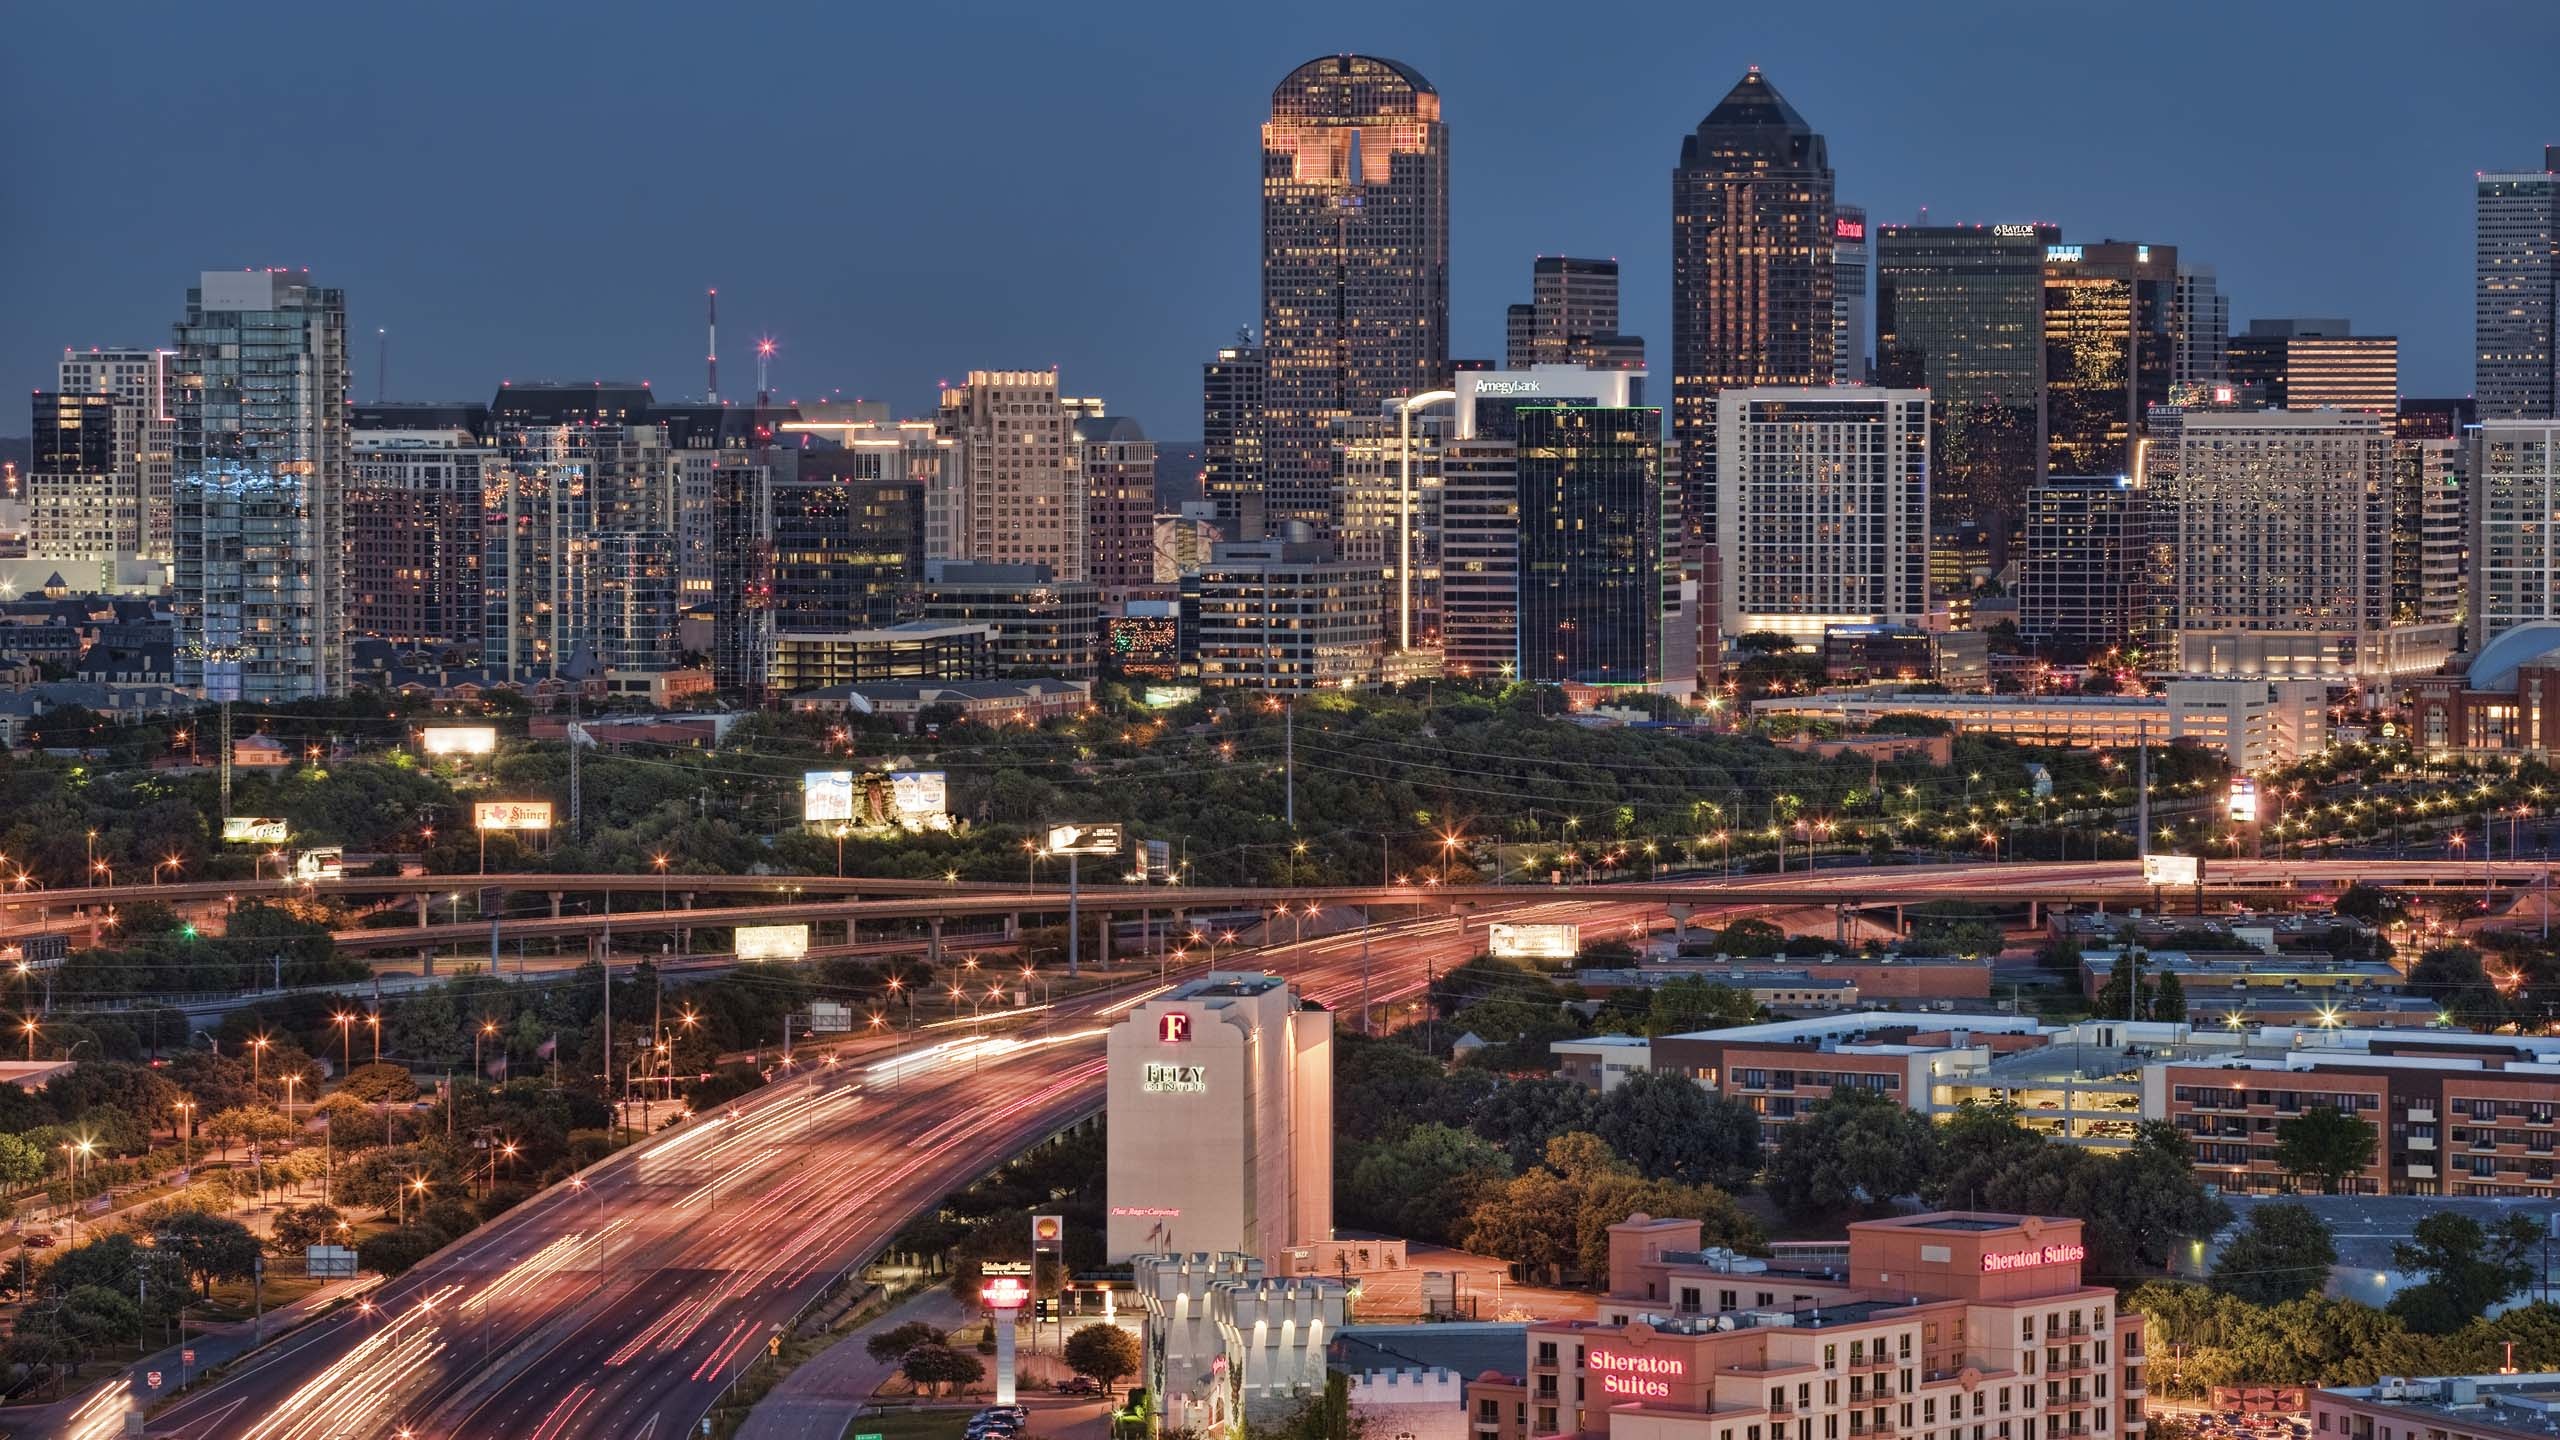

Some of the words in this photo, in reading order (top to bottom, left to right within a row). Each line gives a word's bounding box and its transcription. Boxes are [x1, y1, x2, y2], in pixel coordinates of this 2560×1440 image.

[1837, 219, 1863, 237] Sheraton
[2002, 225, 2034, 233] BAYLOR
[2046, 253, 2080, 263] KPMG
[509, 806, 548, 822] Shiner
[1165, 1014, 1186, 1042] F
[1144, 1064, 1204, 1082] FEIZY
[1144, 1082, 1205, 1092] CENTER
[1983, 1250, 2042, 1272] Sheraton
[2043, 1244, 2085, 1264] Suites
[1590, 1351, 1683, 1375] Sheraton
[1604, 1374, 1669, 1397] Suites
